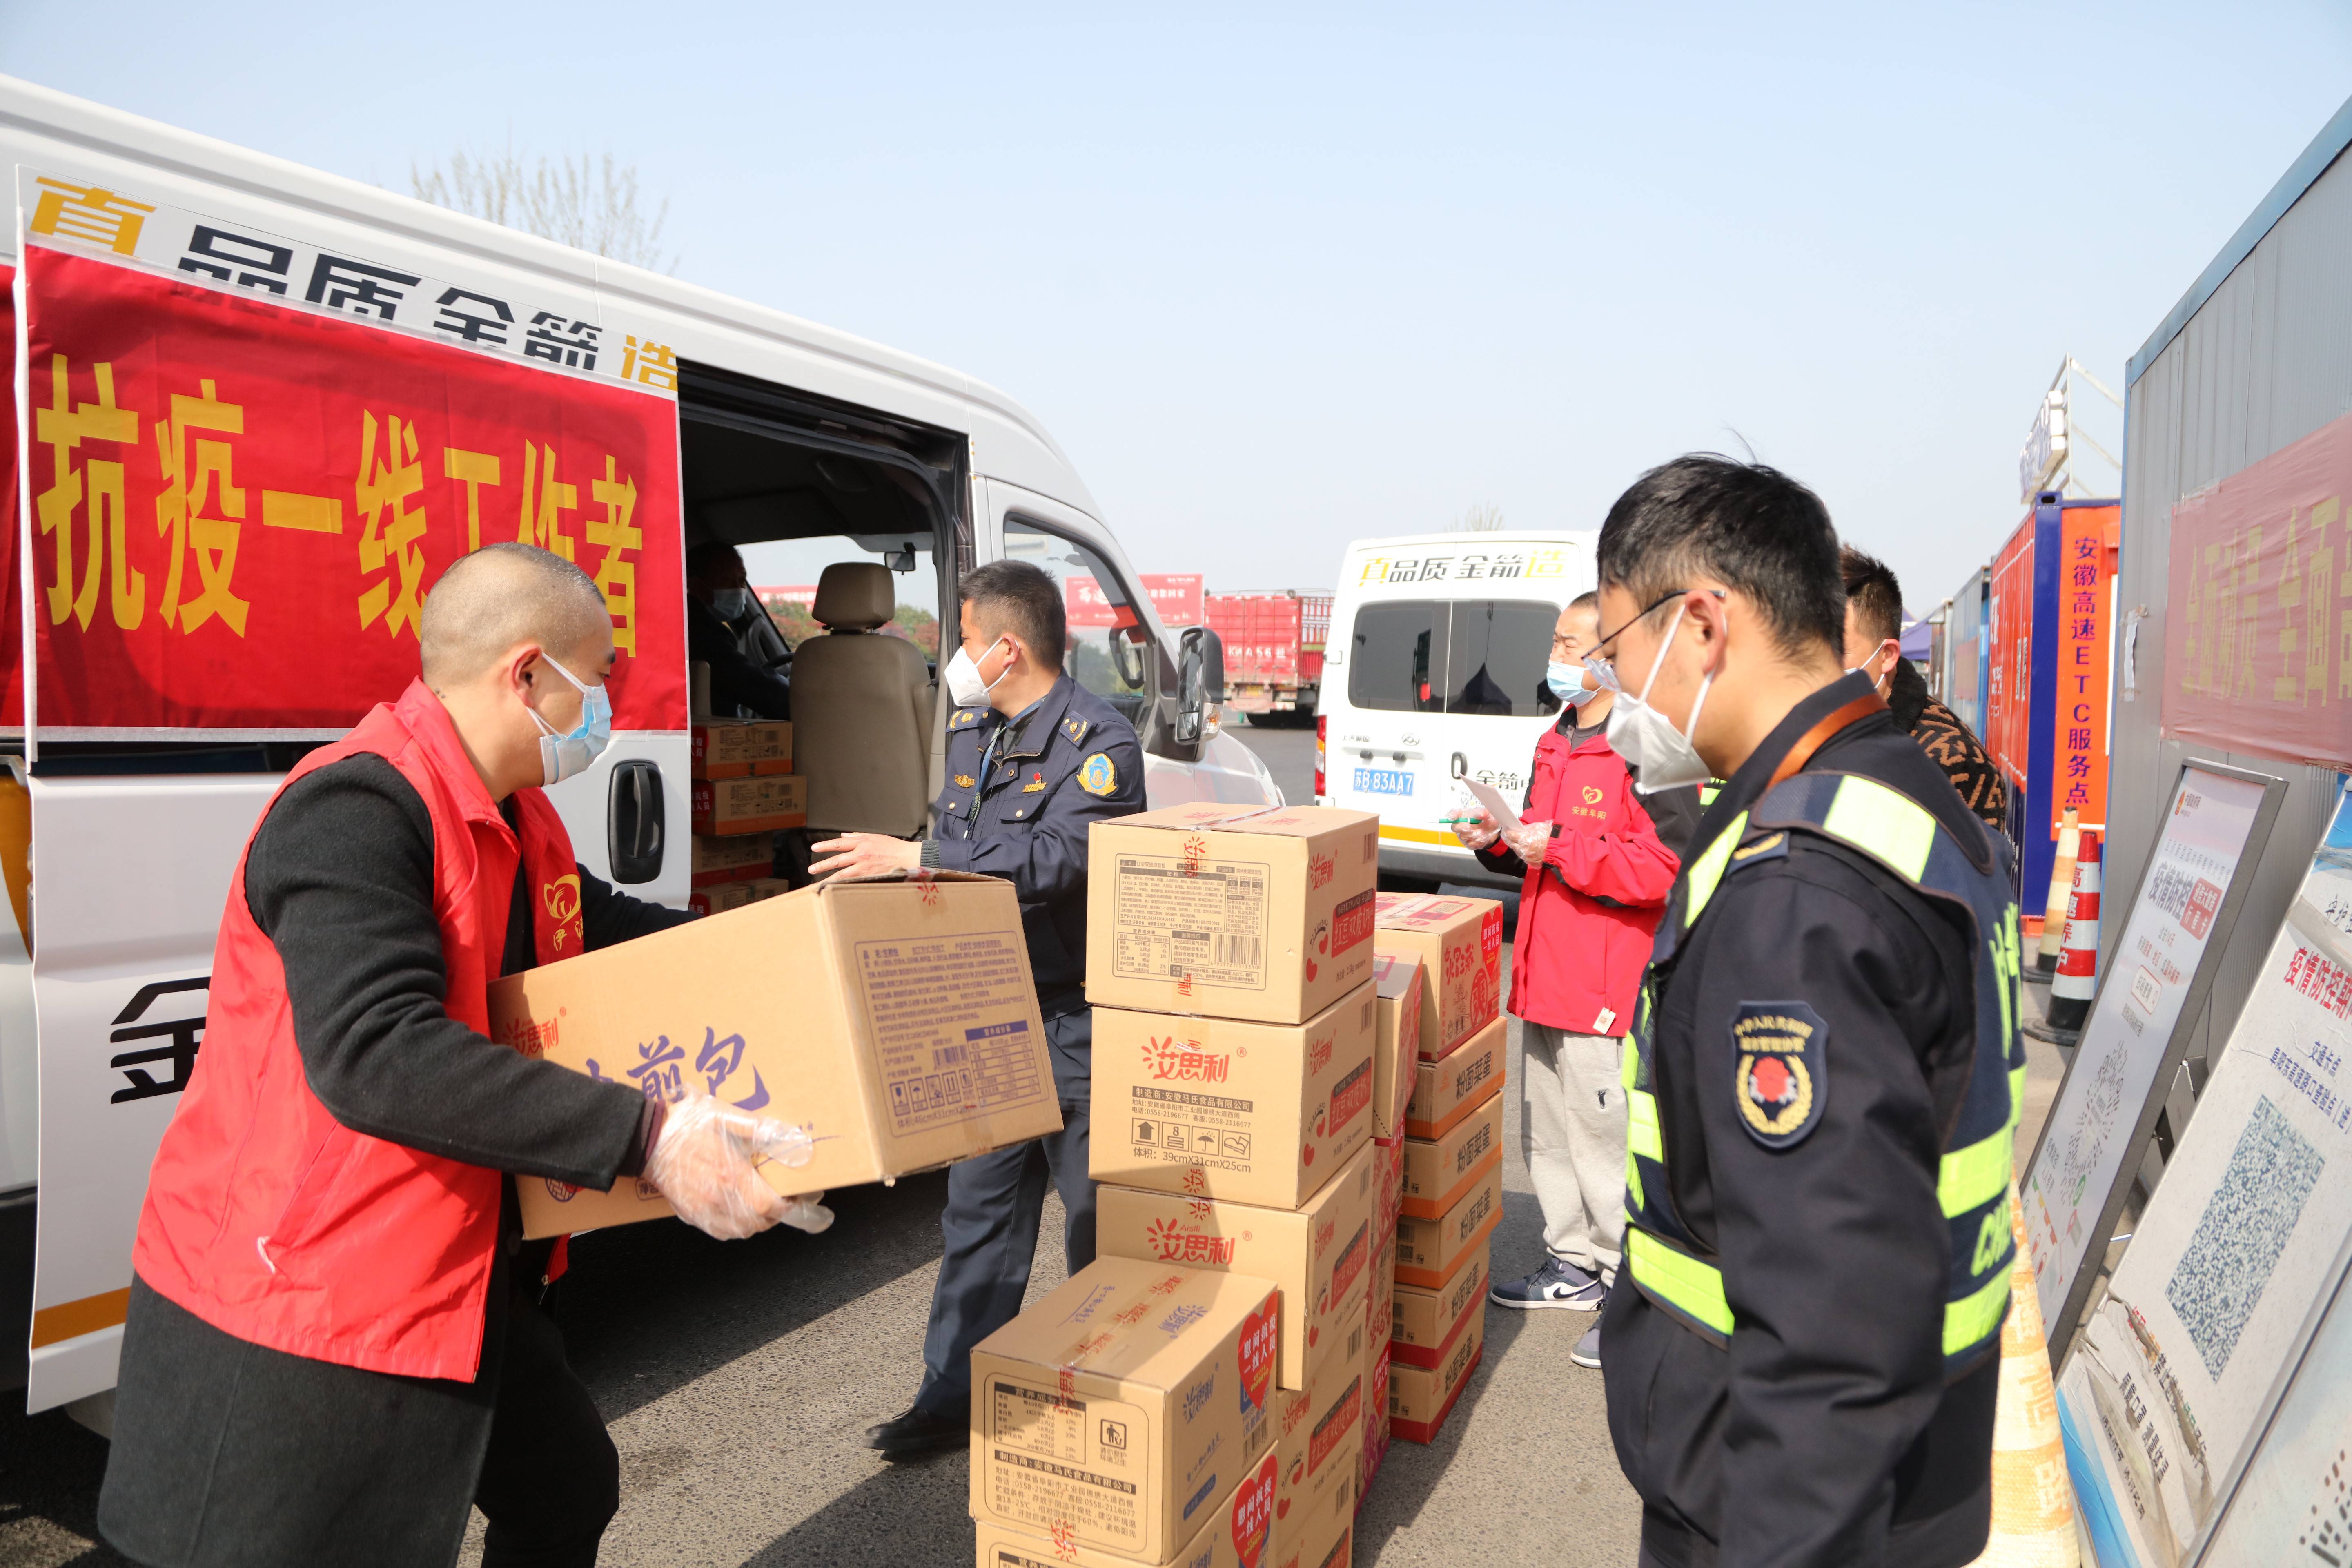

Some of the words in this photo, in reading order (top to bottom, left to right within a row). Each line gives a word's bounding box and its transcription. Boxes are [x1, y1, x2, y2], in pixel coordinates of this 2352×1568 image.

[1145, 588, 1186, 598] 迎您回家
[2065, 537, 2098, 804] 安徽高速ETC服务点
[1572, 806, 1606, 820] 安徽阜阳
[2149, 861, 2194, 920] 疫情防控
[2184, 905, 2208, 935] 行程卡
[586, 1026, 770, 1111] 煎包
[1456, 1051, 1492, 1100] 粉面菜蛋
[2308, 1040, 2341, 1077] 交通卡点
[1132, 1107, 1188, 1120] 电话:0558-2196677
[1193, 1114, 1252, 1129] 客服:0558-2116677
[1457, 1123, 1490, 1175] 粉面菜蛋
[1158, 1233, 1236, 1266] 艾思利
[1244, 1314, 1276, 1360] 慰问抗疫
[1244, 1334, 1276, 1374] 一线人员
